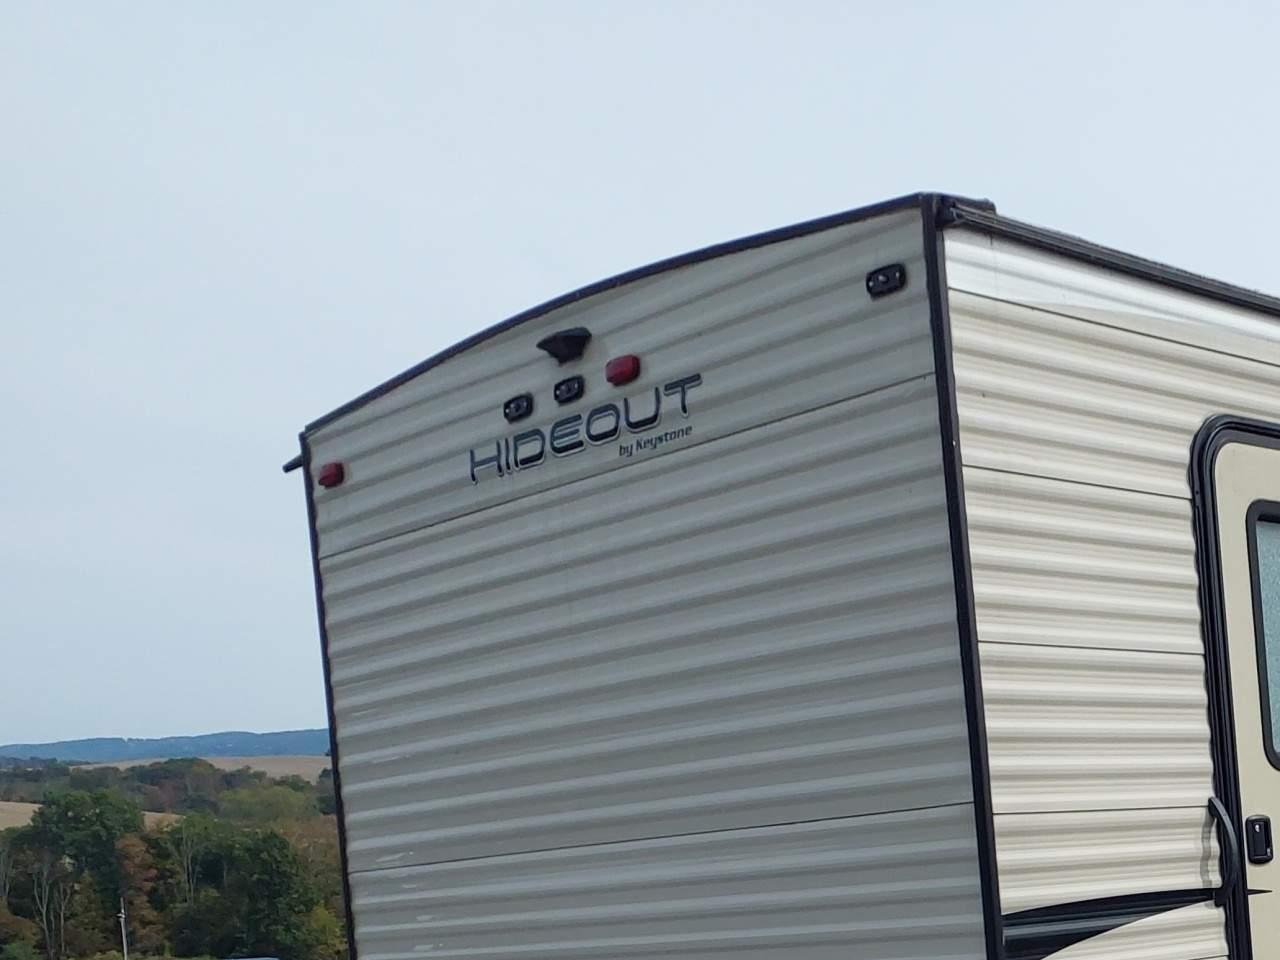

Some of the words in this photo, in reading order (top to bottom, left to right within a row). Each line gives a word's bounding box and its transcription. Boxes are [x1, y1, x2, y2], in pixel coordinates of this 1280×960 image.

[470, 373, 702, 486] HIDEOUT
[618, 442, 634, 458] by
[635, 425, 693, 452] Keystone
